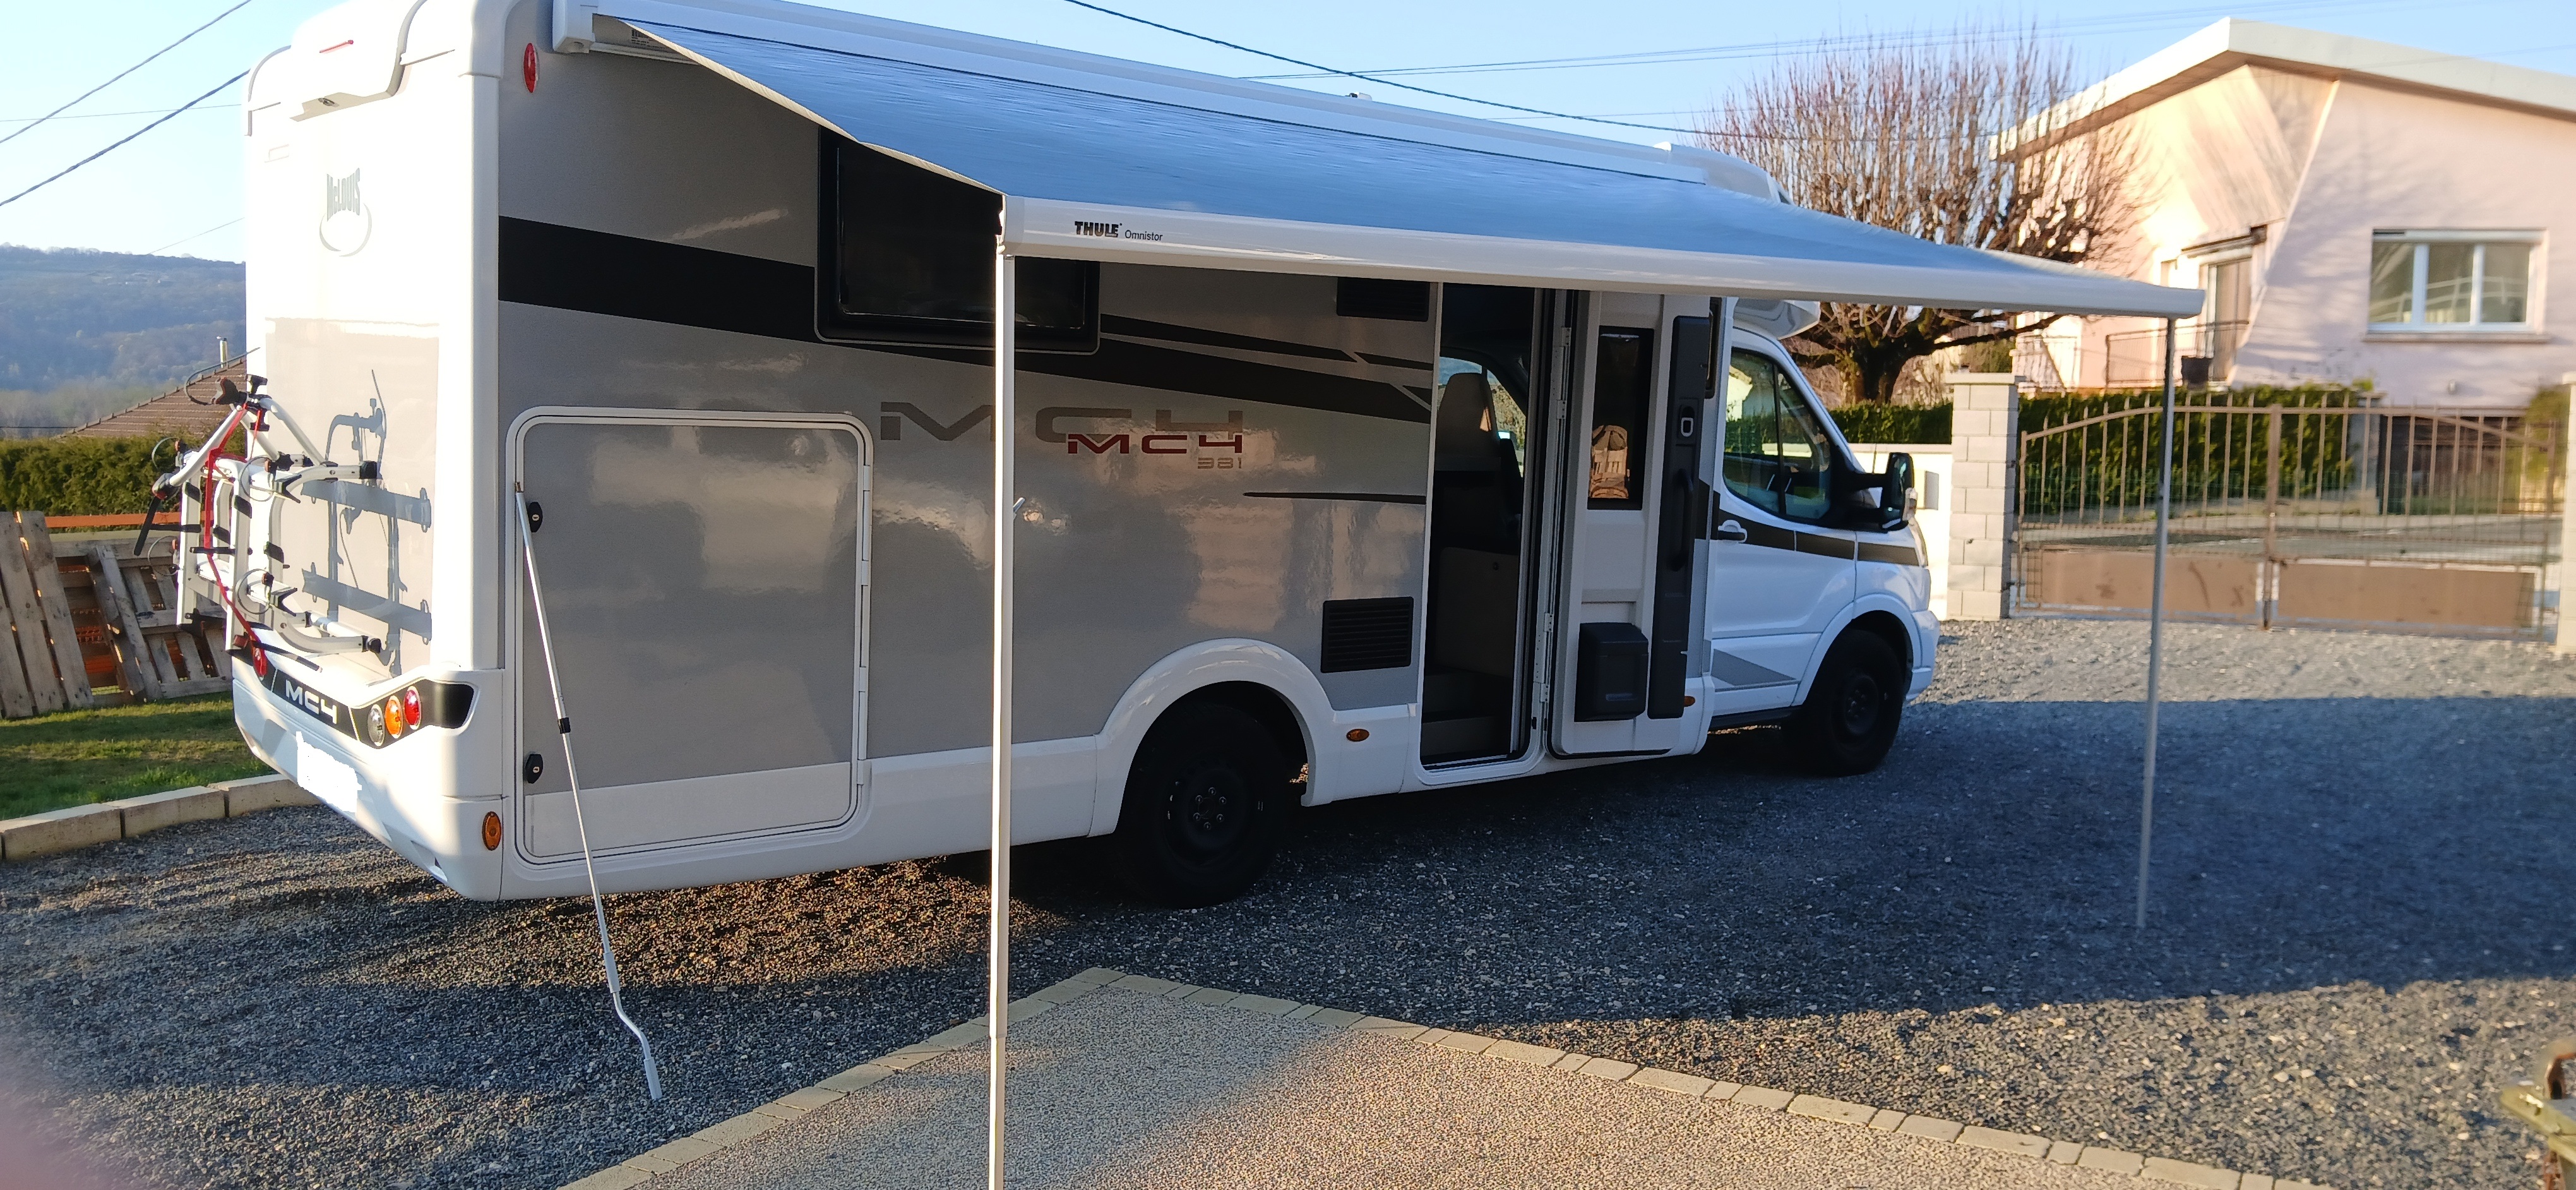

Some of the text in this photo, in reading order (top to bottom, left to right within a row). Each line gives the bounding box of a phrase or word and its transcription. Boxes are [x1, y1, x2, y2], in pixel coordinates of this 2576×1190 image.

[1075, 221, 1163, 241] THULE Omnistor
[881, 402, 1243, 442] MC4
[1068, 434, 1243, 454] MC4
[285, 679, 337, 724] MC4
